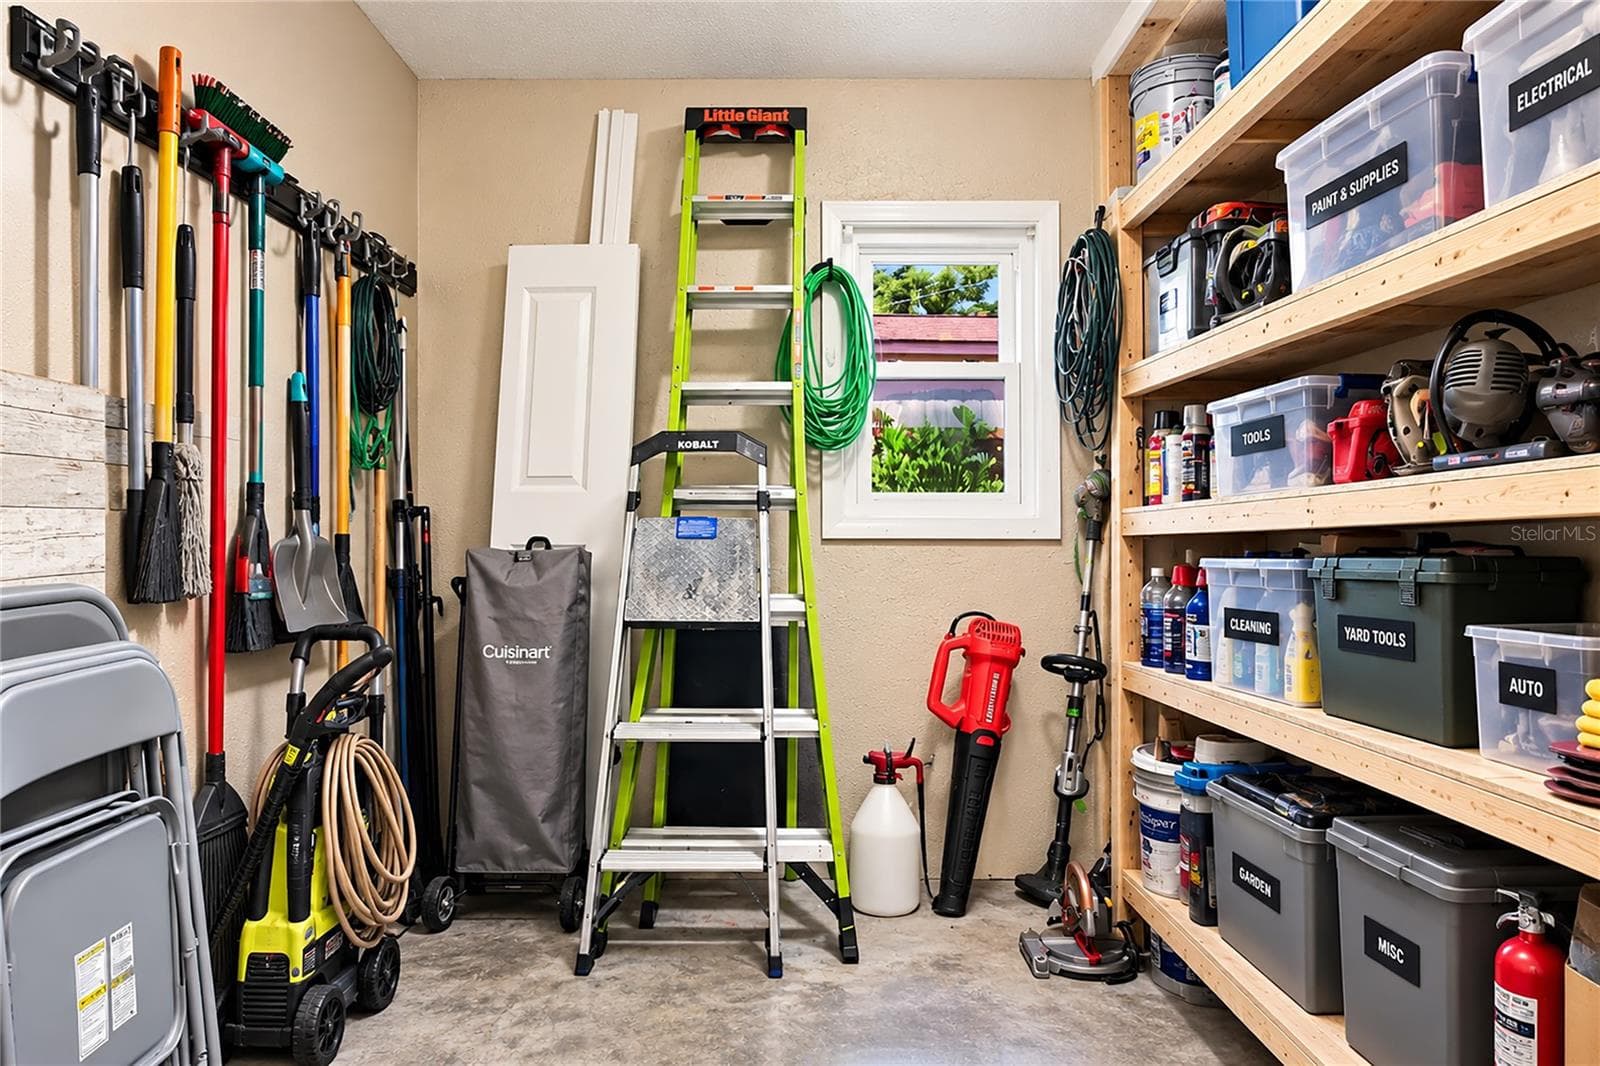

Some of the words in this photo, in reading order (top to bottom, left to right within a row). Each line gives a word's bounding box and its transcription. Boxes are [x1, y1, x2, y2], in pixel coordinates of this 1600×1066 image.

[1516, 57, 1593, 113] ELECTRICAL
[703, 108, 744, 122] Little
[746, 108, 789, 122] Giant
[1311, 188, 1338, 217] PAINT
[1340, 186, 1348, 201] &
[1350, 158, 1400, 197] SUPPLIES
[677, 440, 719, 449] KOBALT
[1242, 429, 1271, 446] TOOLS
[1230, 617, 1272, 636] CLEANING
[1344, 627, 1370, 643] YARD
[1372, 630, 1406, 648] TOOLS
[482, 644, 552, 659] Cuisinart
[1509, 678, 1543, 698] AUTO
[1239, 866, 1272, 898] GARDEN
[1378, 937, 1404, 964] MISC
